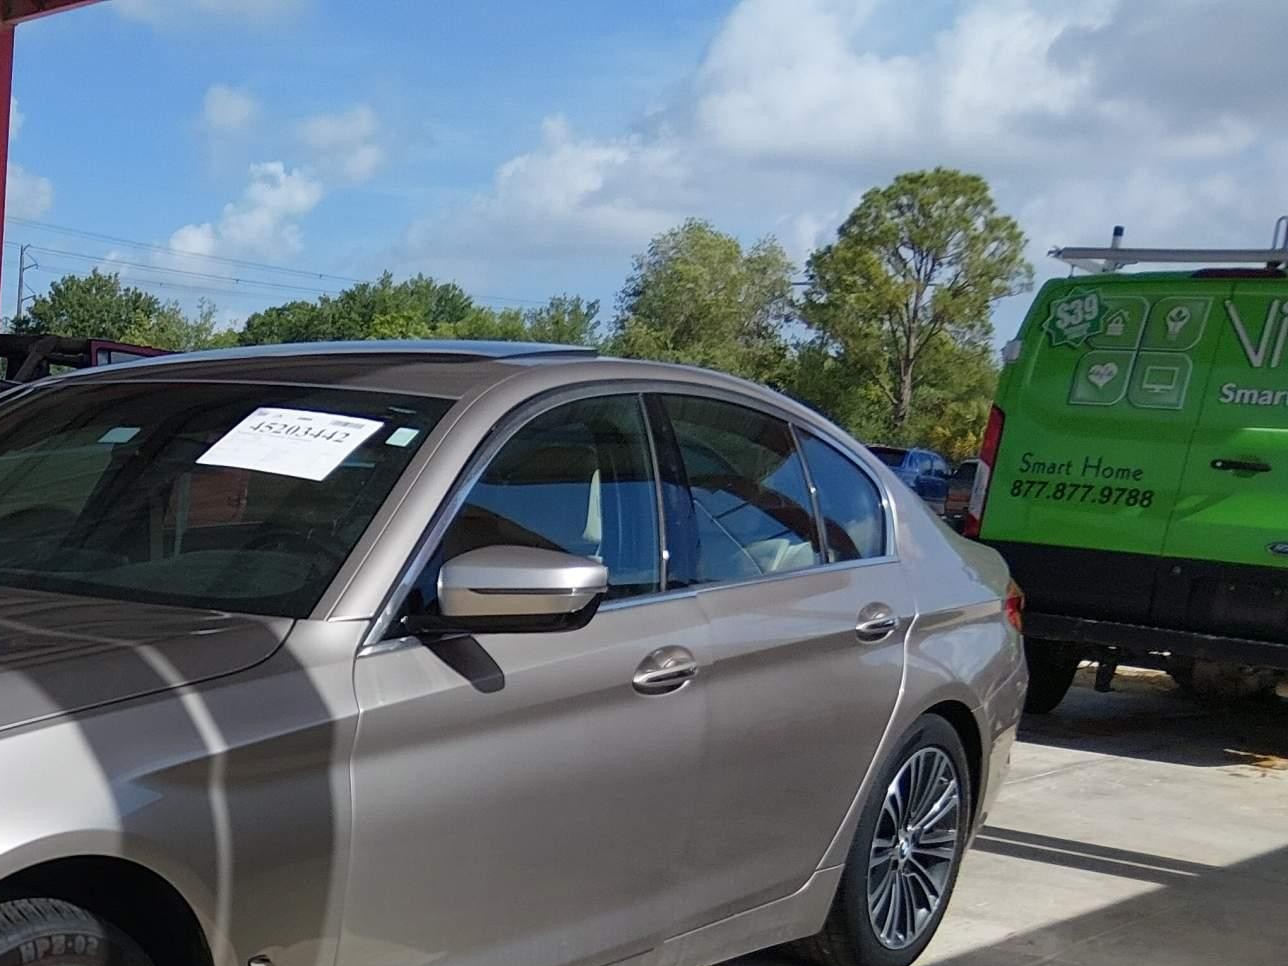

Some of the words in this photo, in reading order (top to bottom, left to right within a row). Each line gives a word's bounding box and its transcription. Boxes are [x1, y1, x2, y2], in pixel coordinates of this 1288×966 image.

[1220, 383, 1288, 405] Smar
[250, 422, 349, 442] 45203442
[1020, 453, 1071, 475] Smart
[1082, 456, 1143, 480] Home
[1011, 480, 1154, 507] 877.877.9788
